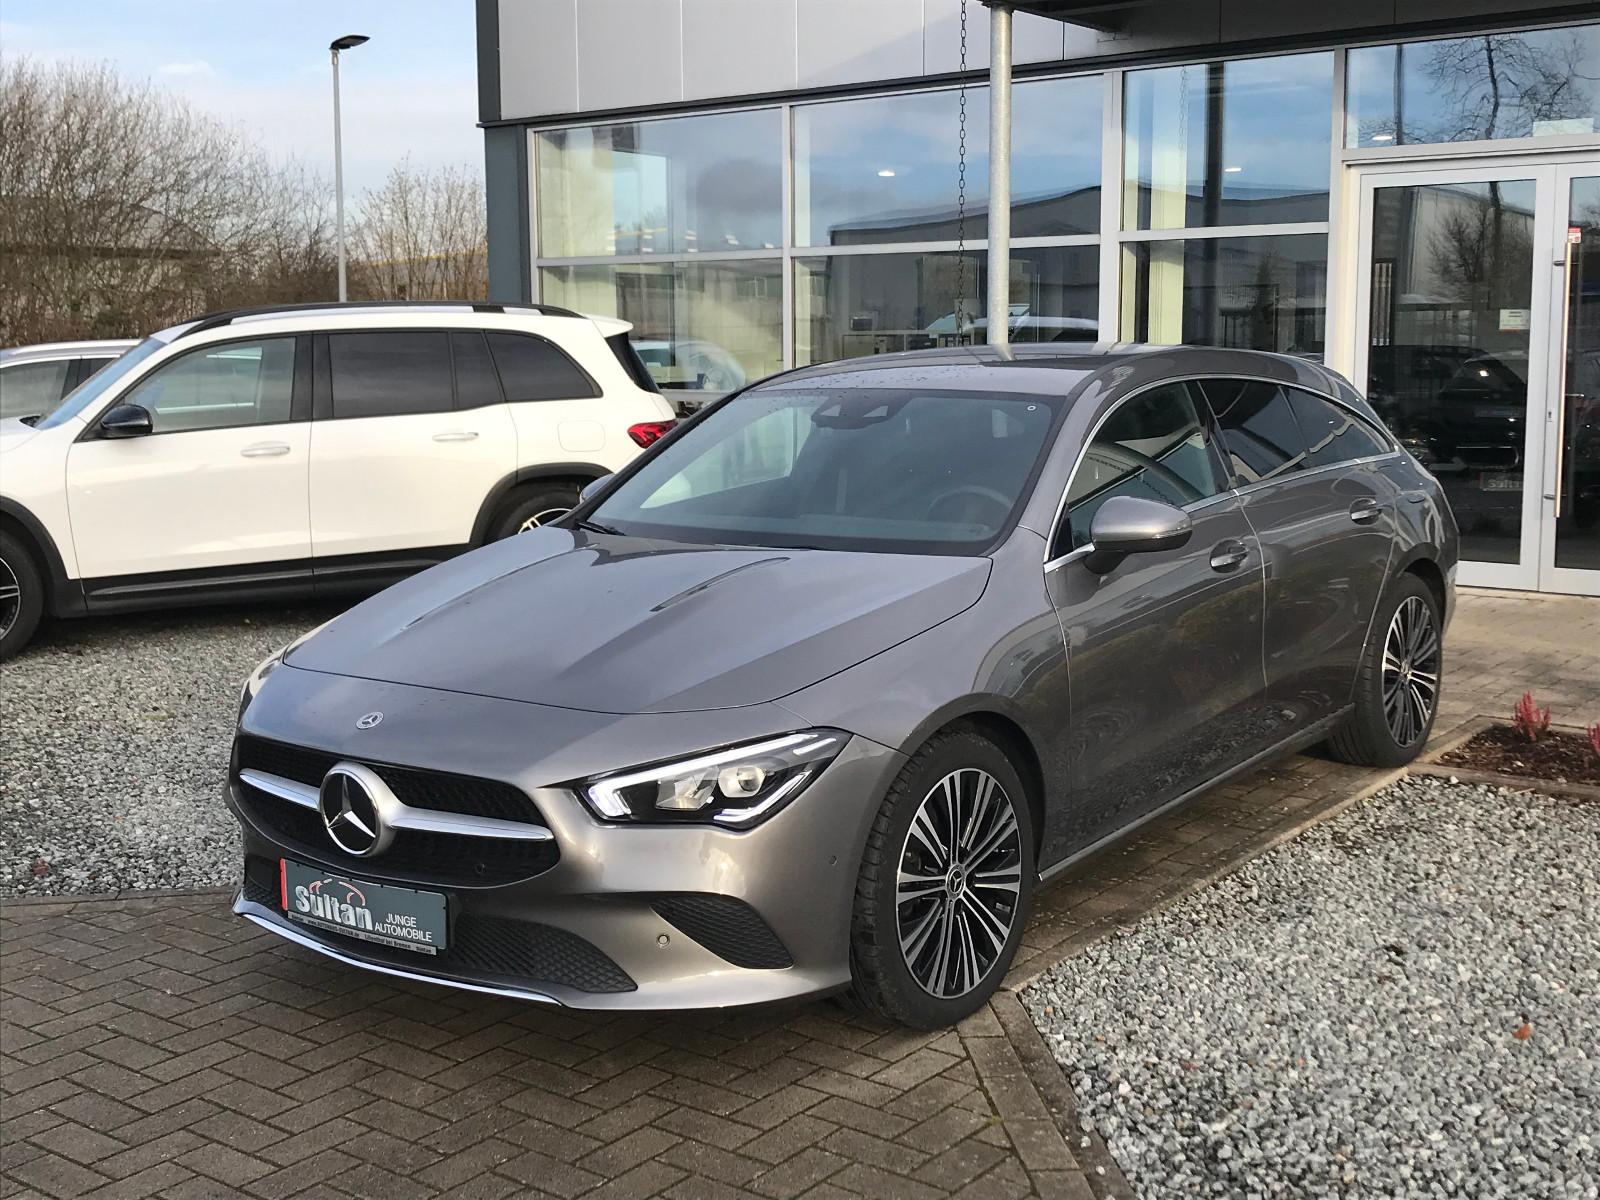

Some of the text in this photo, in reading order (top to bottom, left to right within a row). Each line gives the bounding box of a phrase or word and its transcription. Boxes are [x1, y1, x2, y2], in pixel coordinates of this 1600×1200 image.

[295, 885, 373, 930] Sultan
[386, 912, 417, 928] JUNGE
[374, 921, 433, 943] AUTOMOBILE
